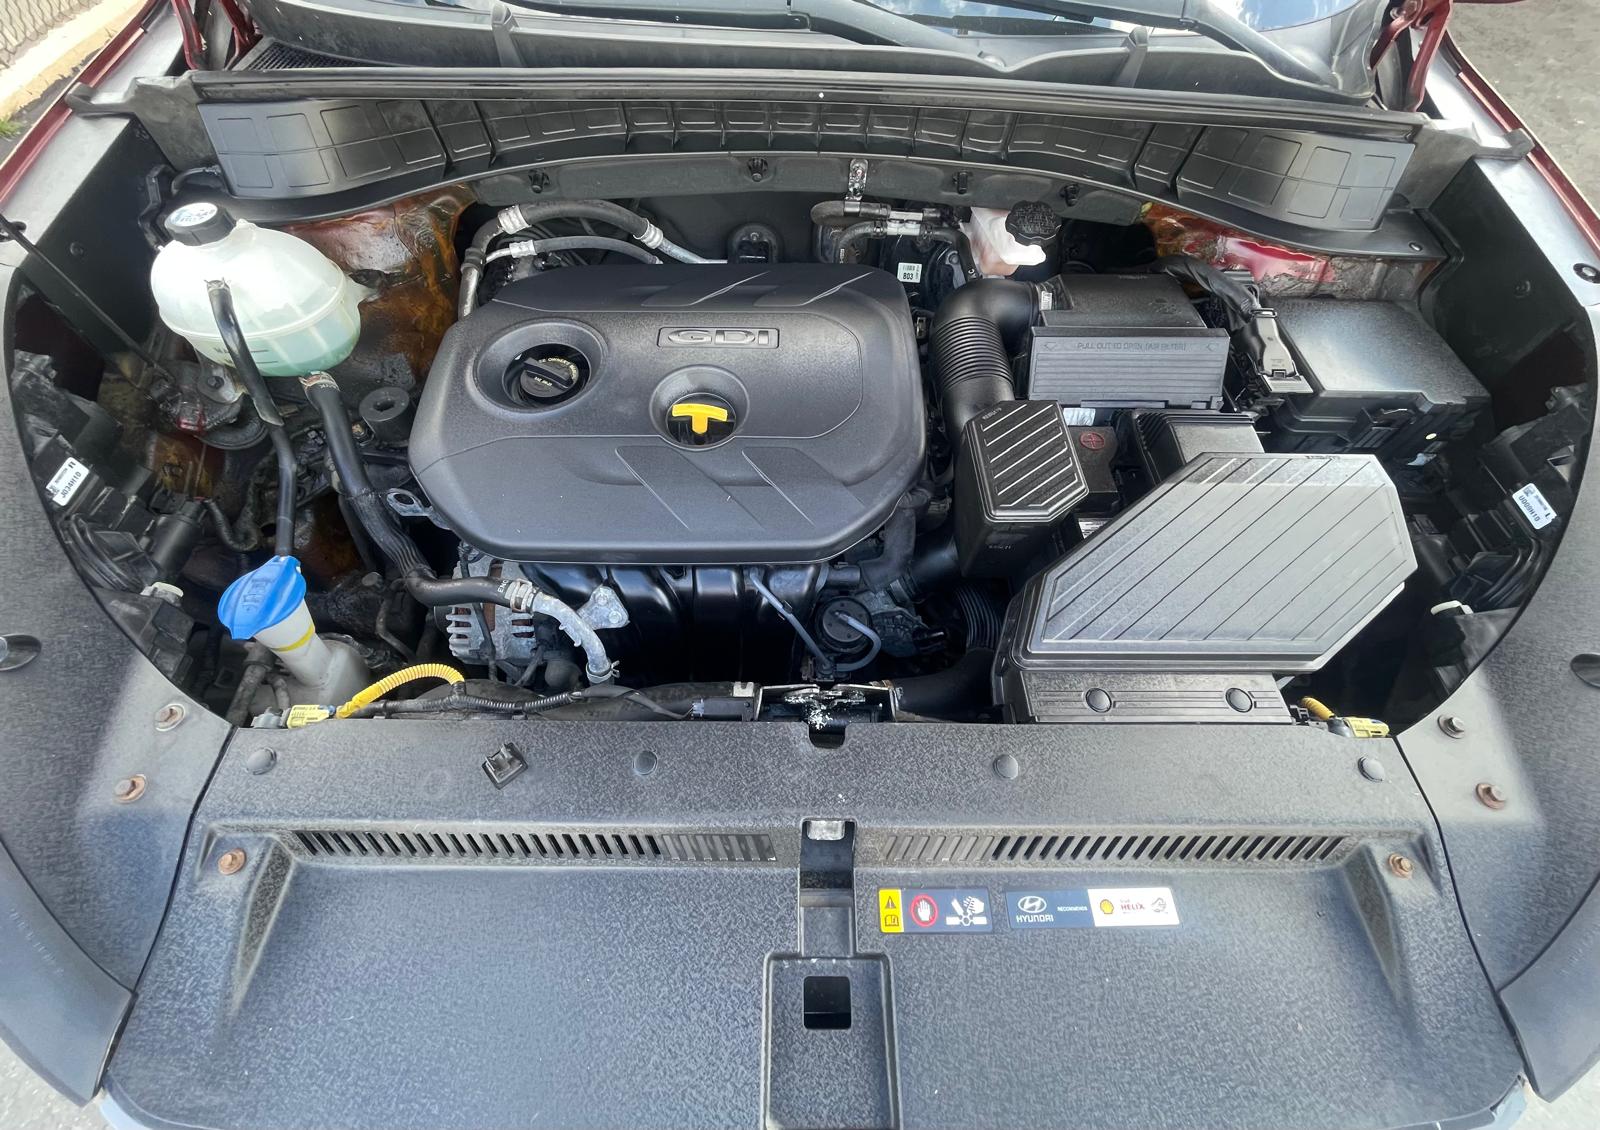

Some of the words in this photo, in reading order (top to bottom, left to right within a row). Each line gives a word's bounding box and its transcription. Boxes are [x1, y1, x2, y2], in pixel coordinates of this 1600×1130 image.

[667, 329, 769, 345] GDI
[1077, 342, 1096, 350] PULL
[1097, 342, 1113, 350] OUT
[1120, 902, 1145, 911] HELIX
[1015, 914, 1054, 923] HYUNDAI
